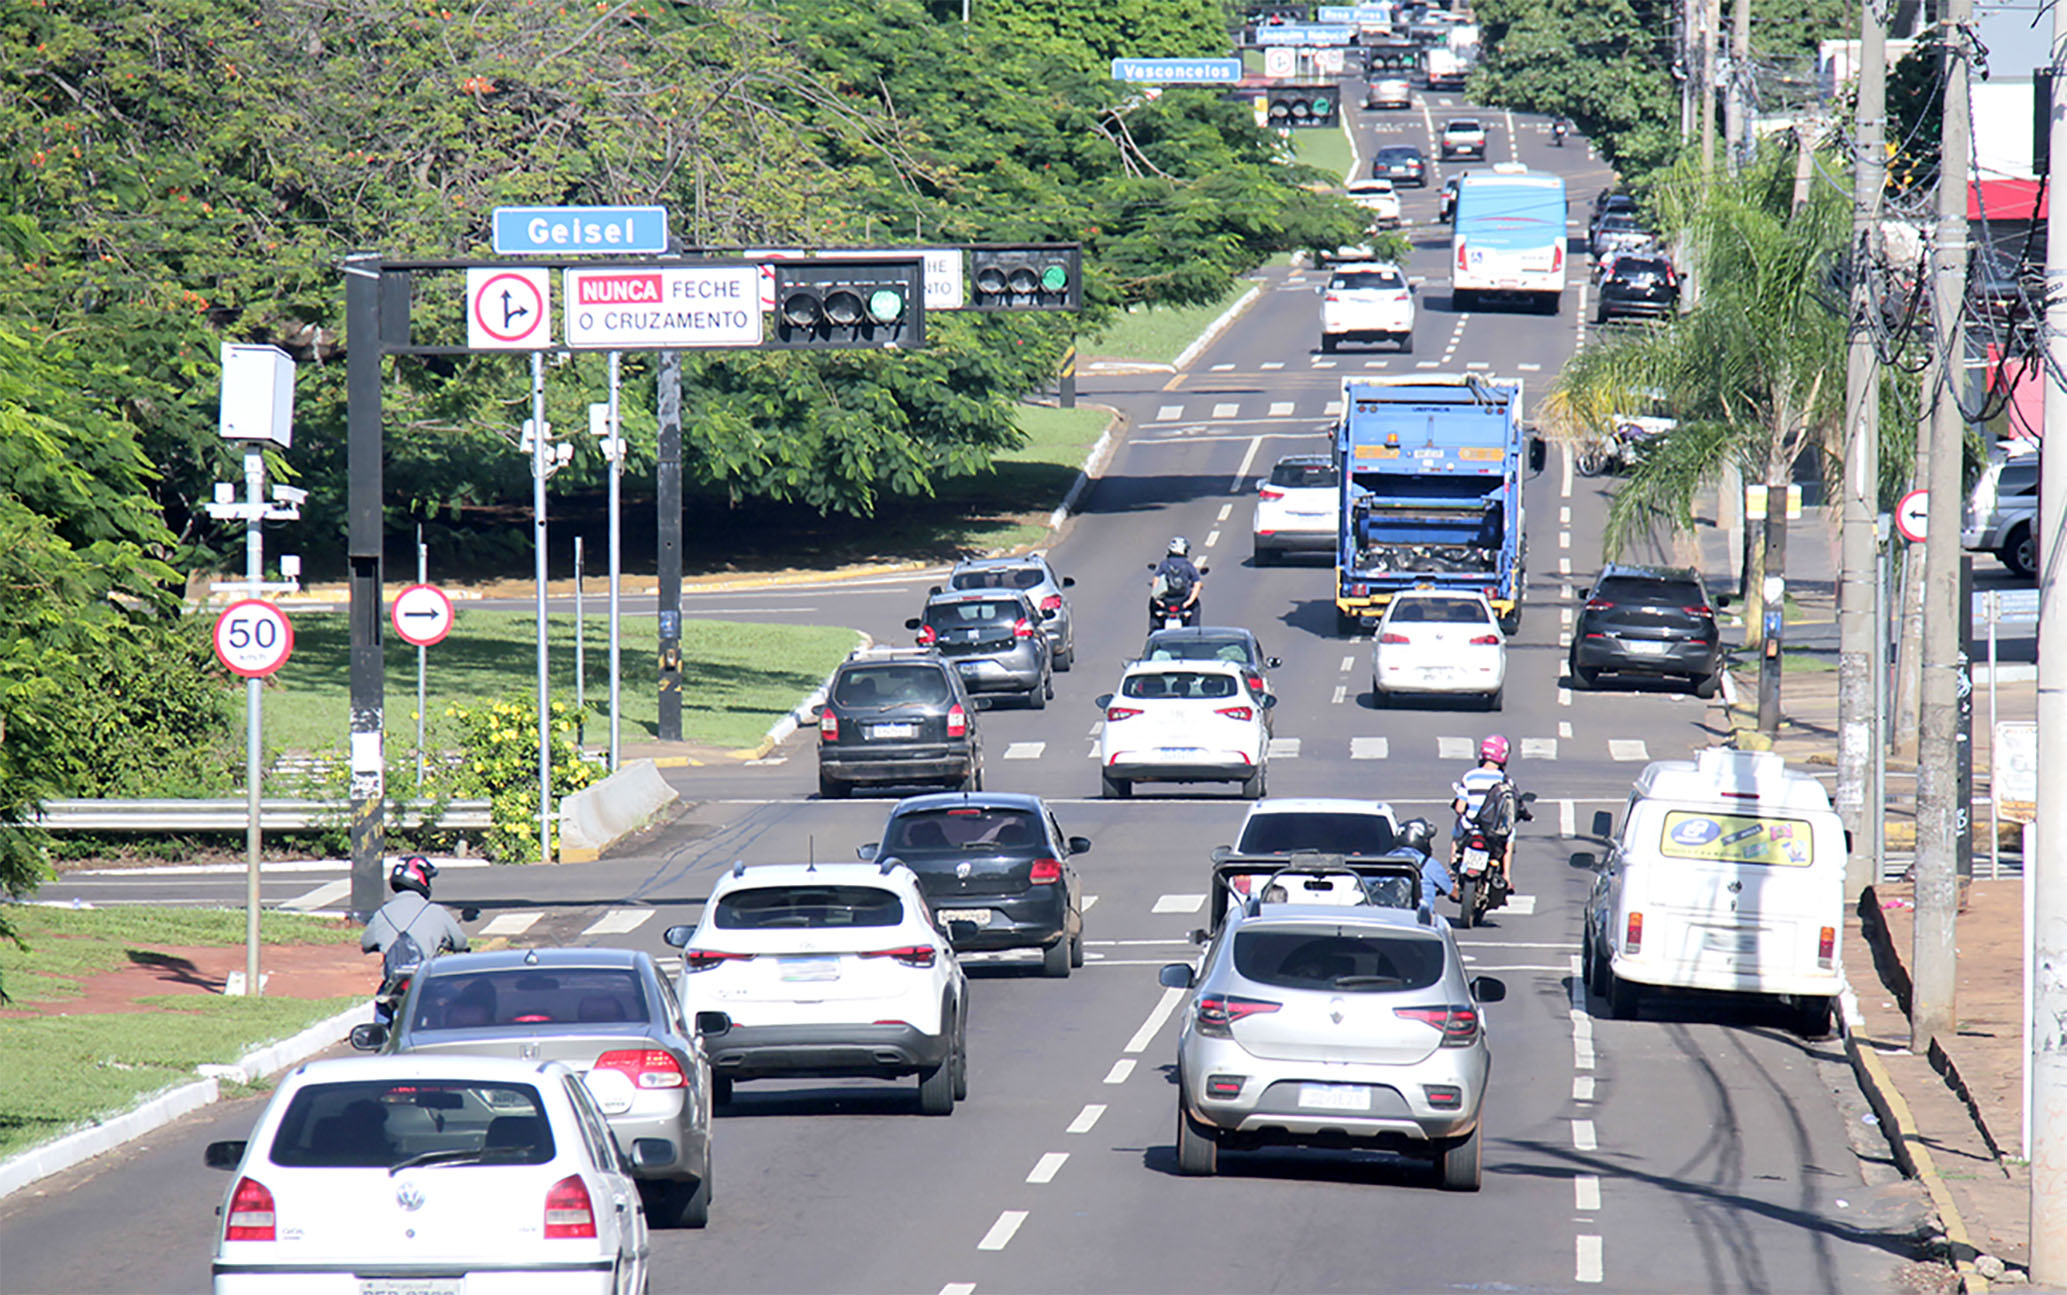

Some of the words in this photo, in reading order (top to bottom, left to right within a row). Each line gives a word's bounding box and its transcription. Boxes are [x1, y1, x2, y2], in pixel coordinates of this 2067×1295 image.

[1123, 64, 1230, 79] Vasconcelos
[528, 217, 634, 244] Geisel
[582, 280, 659, 301] NUNCA
[672, 280, 741, 299] FECHE
[579, 312, 594, 331] O
[604, 310, 748, 330] CRUZAMENTO
[229, 618, 277, 649] 50
